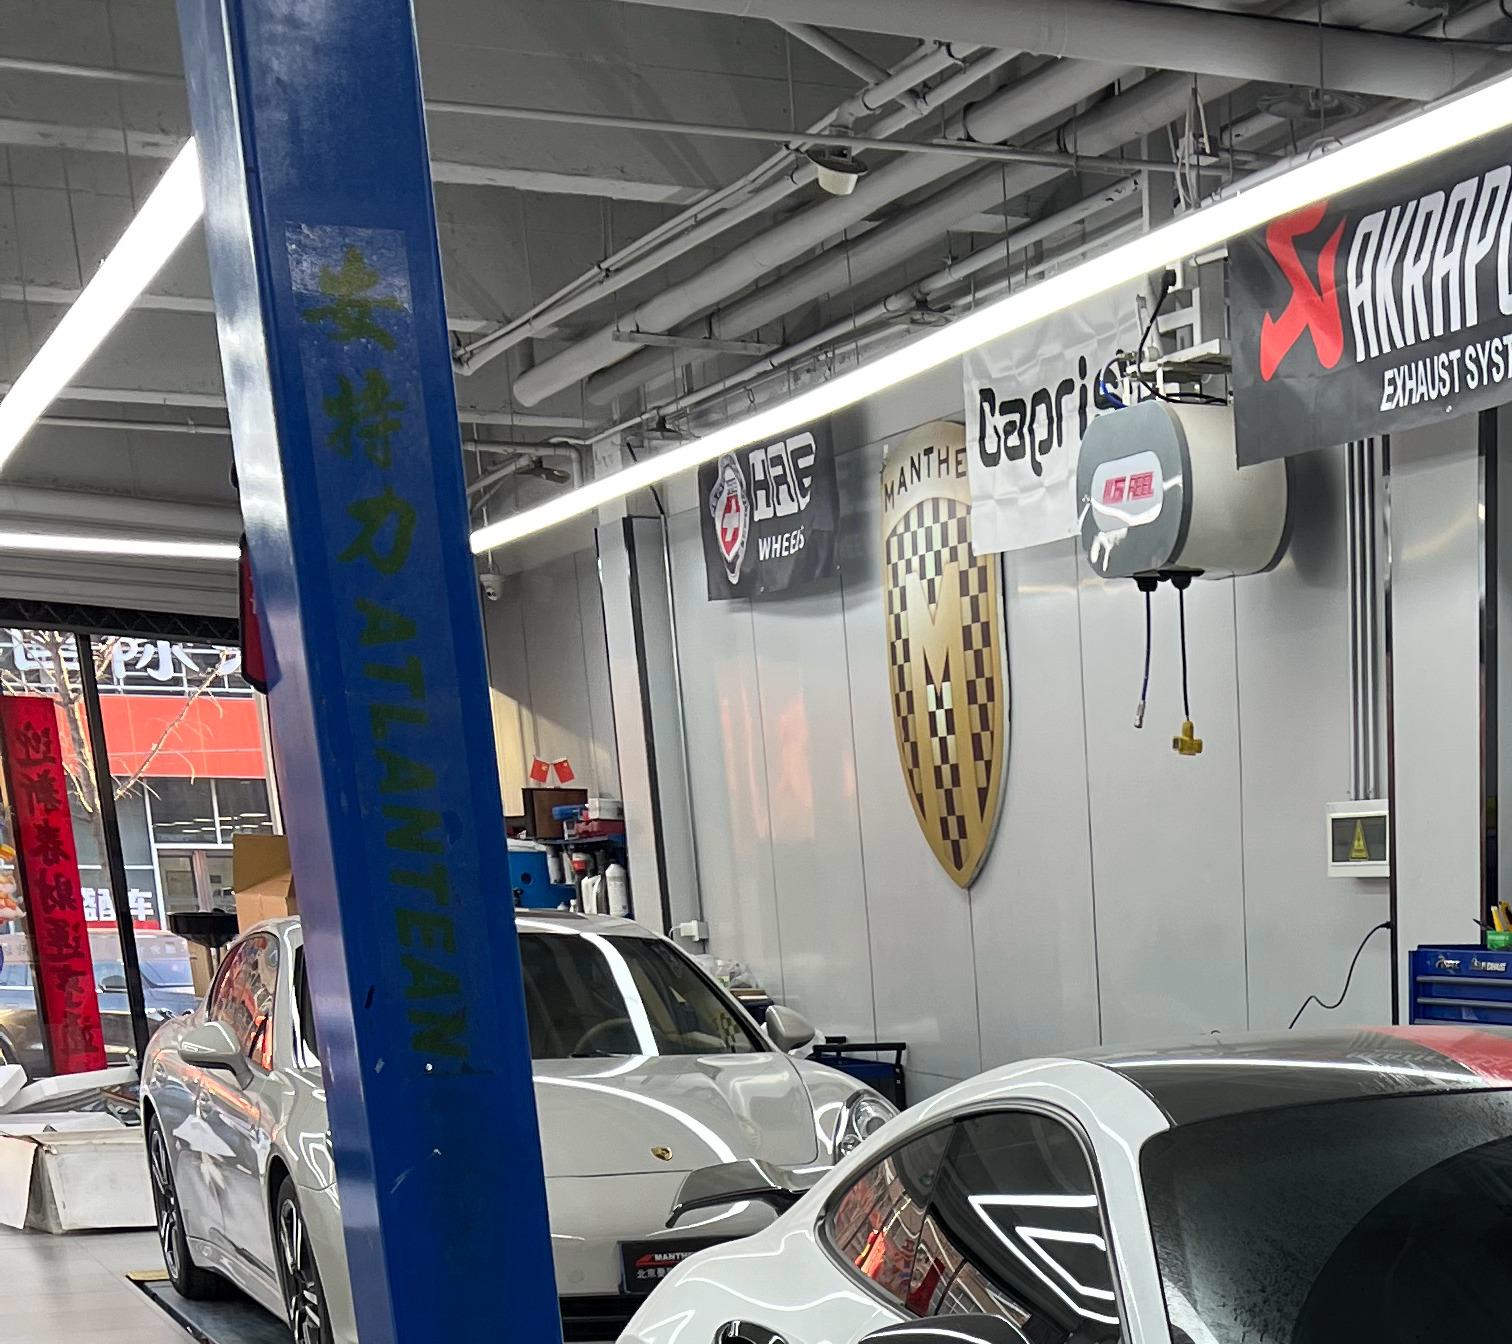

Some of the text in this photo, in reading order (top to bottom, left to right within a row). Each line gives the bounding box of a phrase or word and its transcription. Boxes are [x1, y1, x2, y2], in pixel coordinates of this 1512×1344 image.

[979, 355, 1127, 477] Capris
[1381, 346, 1461, 412] EXHAUST
[749, 430, 816, 522] HRE
[355, 597, 468, 1060] ATLANTEAN
